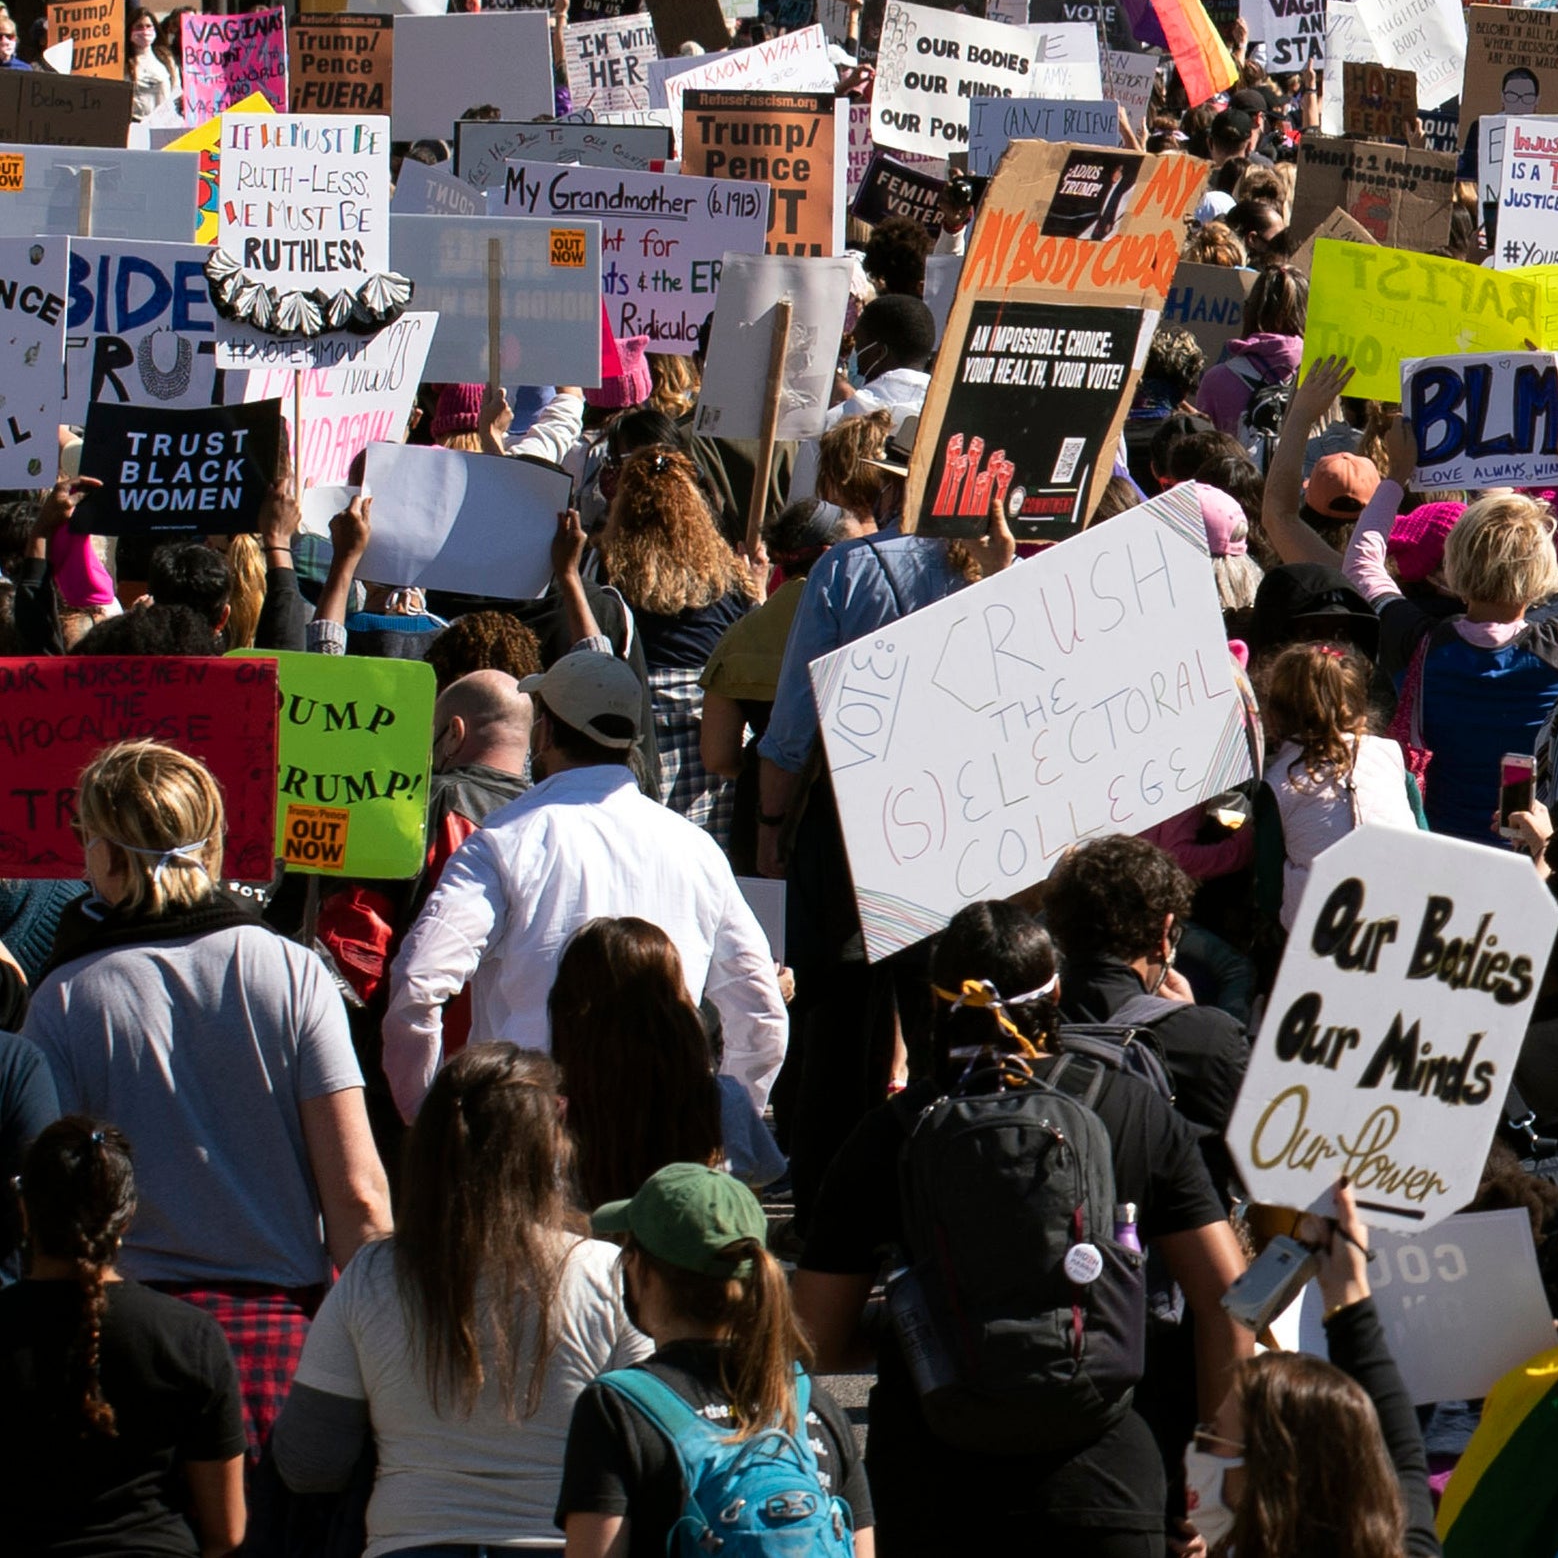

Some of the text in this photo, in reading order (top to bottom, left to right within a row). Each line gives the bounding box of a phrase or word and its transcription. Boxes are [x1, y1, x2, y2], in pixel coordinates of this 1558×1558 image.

[583, 0, 620, 16] ON US
[1506, 10, 1553, 27] WOMEN
[578, 27, 655, 58] I'M WITH
[1476, 22, 1510, 36] BELONG
[1514, 25, 1525, 37] IN
[1528, 27, 1545, 39] ALL
[1484, 38, 1513, 50] WHERE
[917, 37, 1029, 74] OUR BODIES
[1488, 52, 1505, 64] ARE
[1508, 54, 1531, 66] BEING
[589, 57, 643, 86] HER
[905, 71, 1012, 99] OUR MINDS
[700, 94, 818, 109] RefuseFascism.org
[696, 116, 821, 148] Trump/
[880, 108, 921, 131] OUR
[229, 123, 382, 154] IF WE MUST BE
[705, 150, 811, 181] Pence
[1512, 162, 1540, 180] IS A
[505, 166, 541, 211] My
[549, 176, 697, 212] Grandmother
[1060, 179, 1103, 197] TRUMP!
[1135, 155, 1210, 221] MY
[224, 201, 373, 232] WE MUST BE
[245, 237, 367, 273] RUTHLESS.
[963, 208, 1097, 293] MY BODY
[970, 326, 1114, 359] AN IMPOSSIBLE CHOICE:
[961, 359, 1125, 390] YOUR HEALTH, YOUR VOTE!
[127, 429, 249, 456] TRUST
[120, 460, 243, 484] BLACK
[1418, 467, 1463, 486] LOVE
[1473, 462, 1526, 483] ALWAYS
[119, 486, 242, 511] WOMEN
[931, 530, 1175, 712] CRUSH
[989, 678, 1077, 742] THE
[882, 649, 1232, 866] (S)ELECTORAL
[292, 821, 340, 840] OUT
[955, 747, 1203, 899] COLLEGE
[285, 840, 343, 862] NOW
[1312, 876, 1533, 1006] Our Bodies
[1274, 992, 1495, 1106] Our Minds
[1250, 1084, 1451, 1201] Our Power
